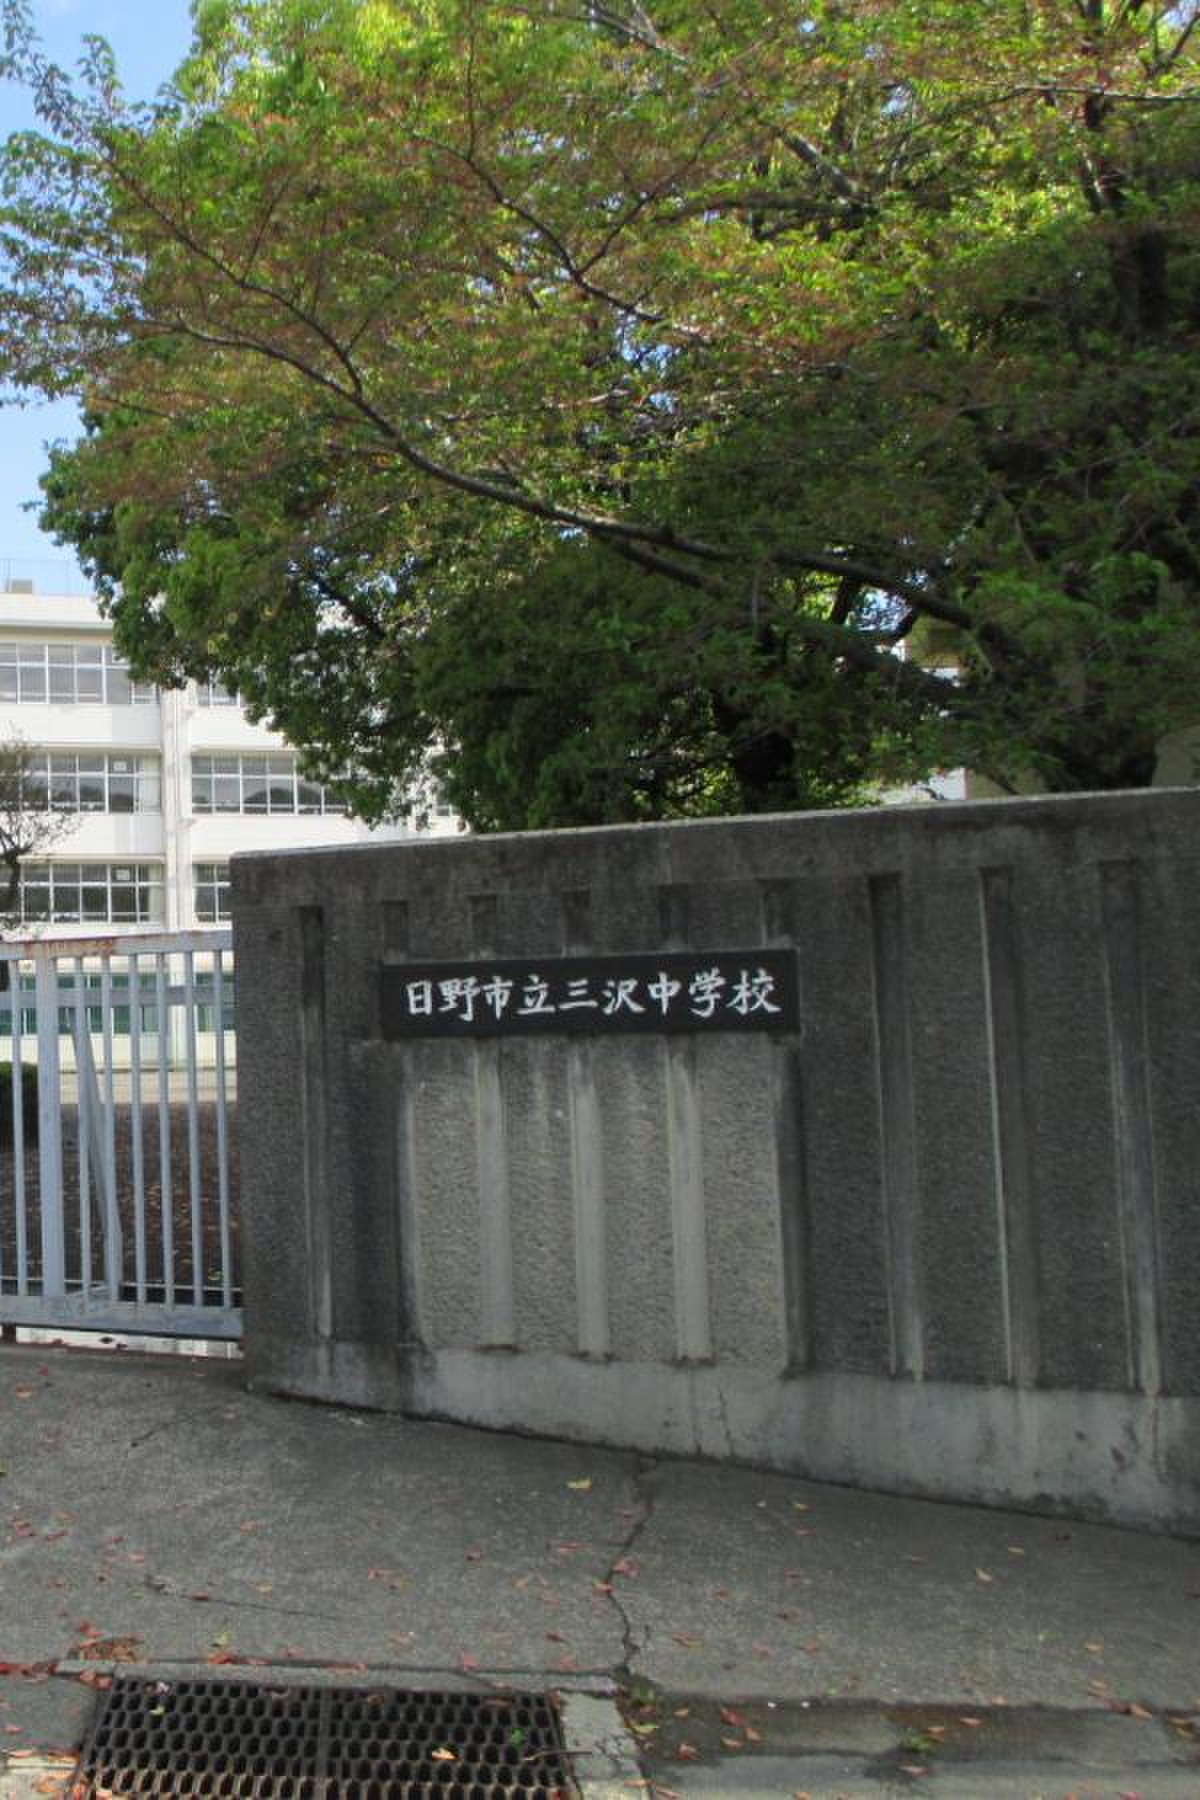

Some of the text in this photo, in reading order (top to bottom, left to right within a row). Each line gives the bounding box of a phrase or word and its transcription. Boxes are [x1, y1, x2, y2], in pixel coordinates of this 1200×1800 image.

[405, 968, 782, 1022] 日野市立三沢中学校
